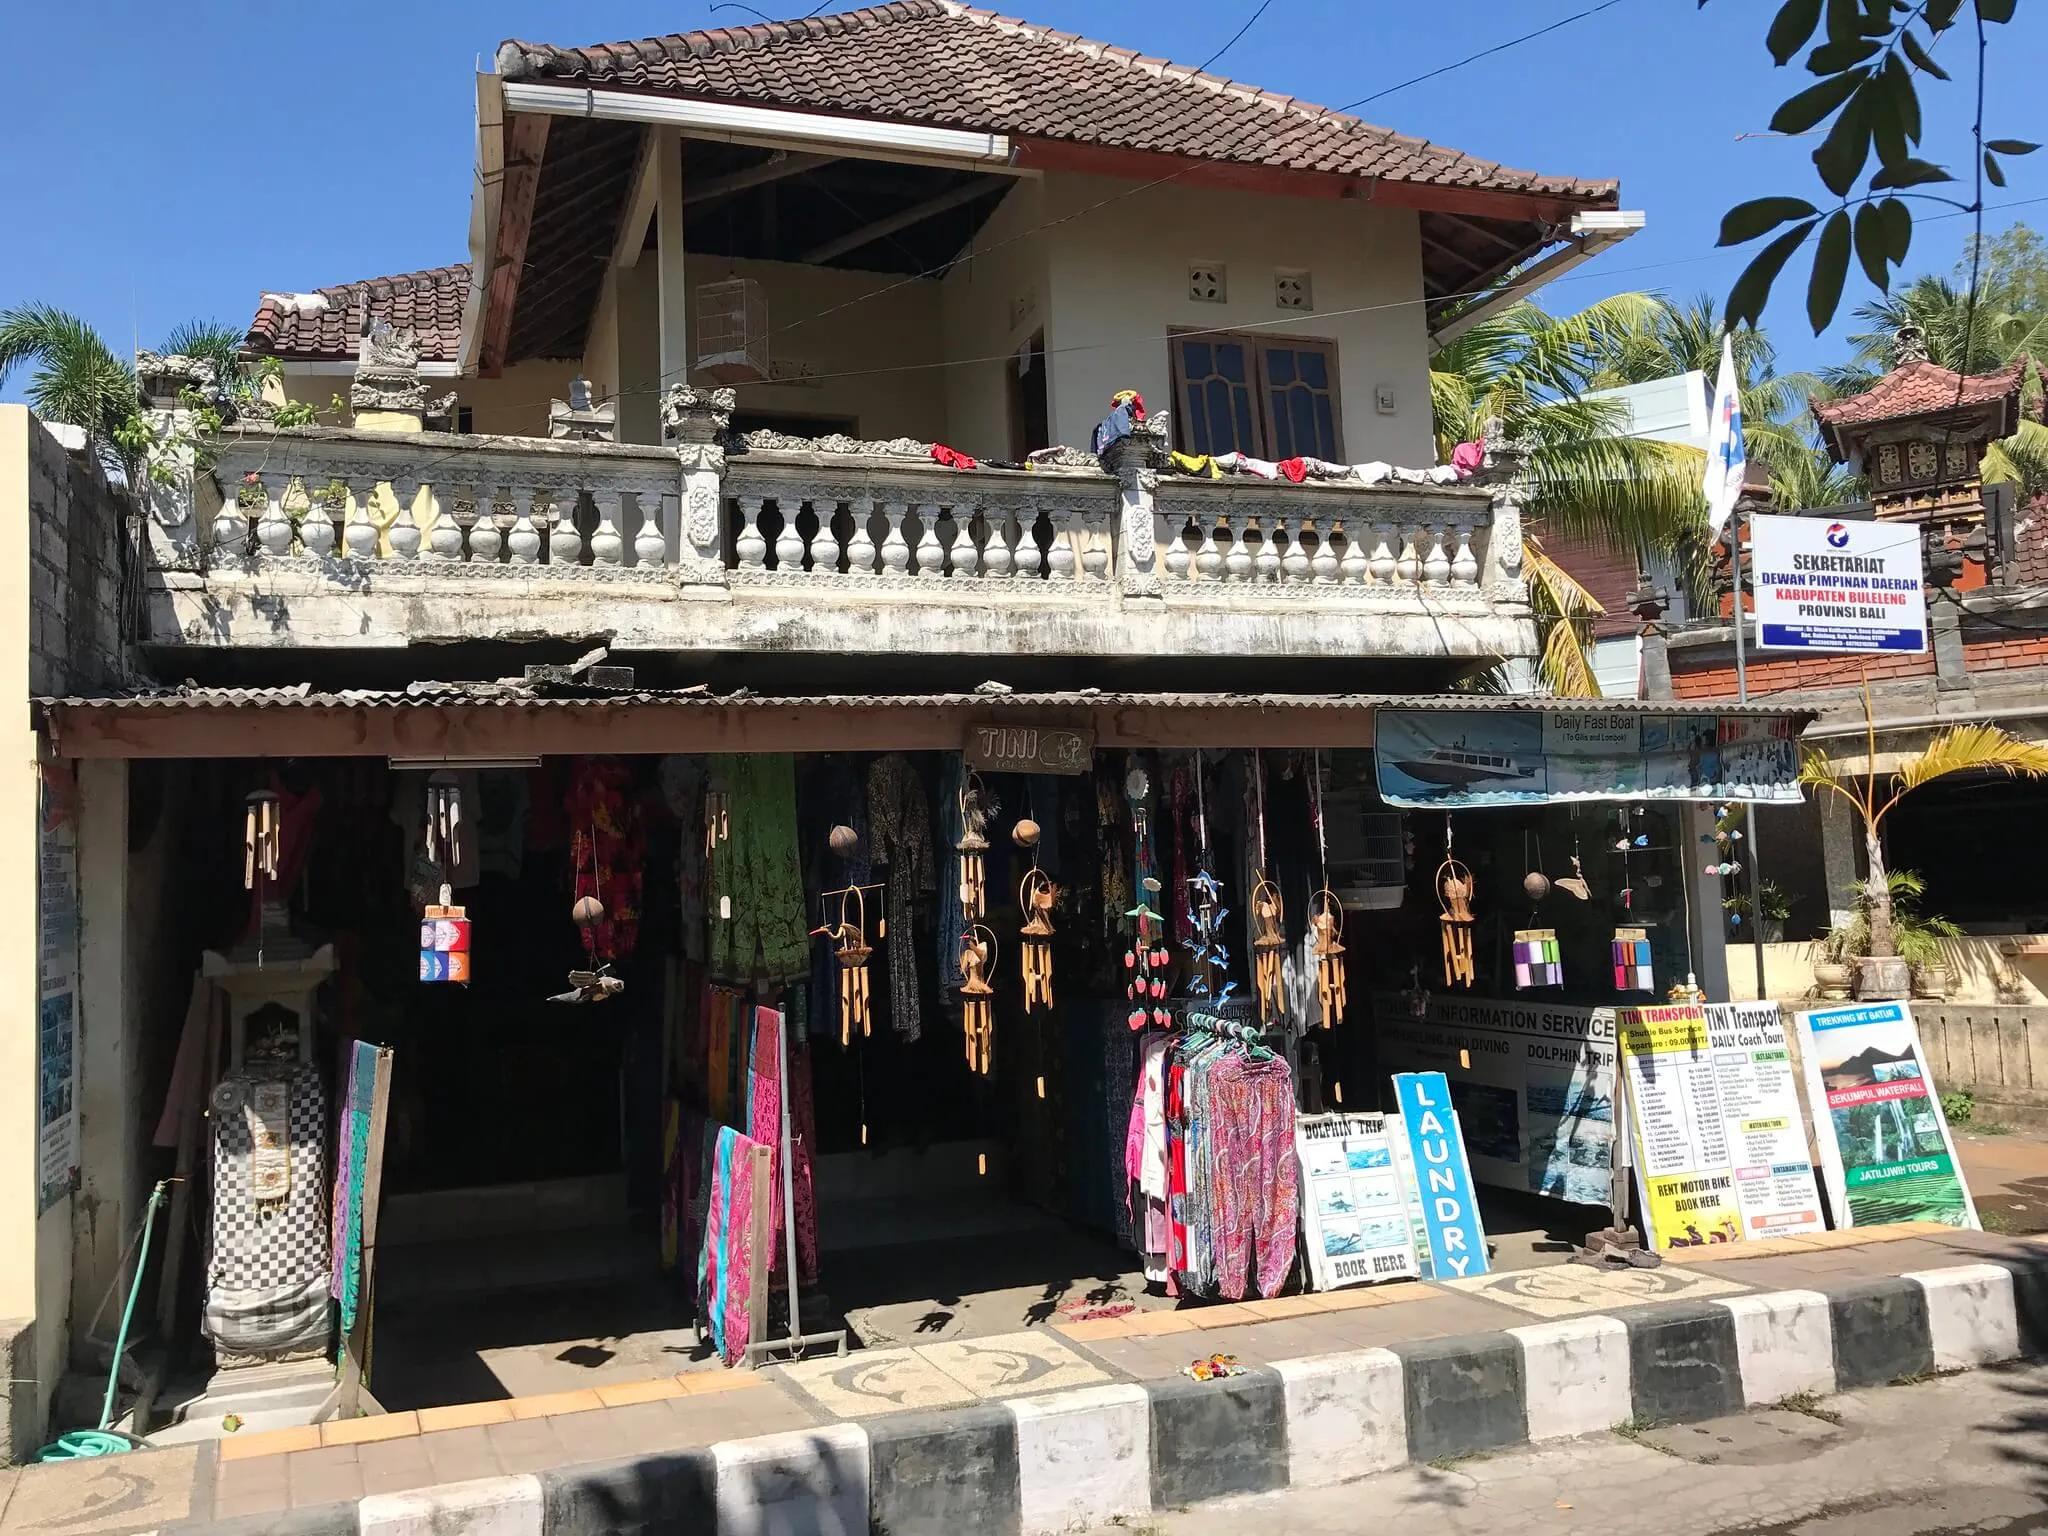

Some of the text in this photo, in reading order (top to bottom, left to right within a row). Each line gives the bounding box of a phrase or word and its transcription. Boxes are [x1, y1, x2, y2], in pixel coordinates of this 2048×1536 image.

[1794, 554, 1885, 573] SEKRETARIAT
[1762, 573, 1918, 590] DEWAN PIMPINAN DAERAH
[1776, 589, 1906, 605] KABUPATEN BULELENG
[1799, 605, 1885, 619] PROVINSI BALI
[1555, 715, 1634, 732] Daily Fast Boat
[978, 728, 1037, 759] TINI
[1437, 1005, 1537, 1030] INFORMATION
[1543, 1015, 1615, 1037] SERVICE
[1621, 1006, 1704, 1024] TINI TRANSPORT
[1705, 1005, 1782, 1032] TINI Transport
[1817, 1009, 1894, 1027] TREKKING MT BATUR
[1630, 1029, 1656, 1037] Shuttle
[1712, 1032, 1784, 1048] DAILY Coach Tours
[1472, 1039, 1509, 1054] DIVING
[1625, 1041, 1662, 1050] Departure
[1669, 1038, 1689, 1046] 09.00
[1528, 1044, 1614, 1067] DOLPHIN TRIP
[1830, 1083, 1925, 1105] SEKUMPUL WATERFALL
[1305, 1122, 1352, 1140] DOLPHIN
[1415, 1083, 1469, 1277] LAUNDRY
[1859, 1160, 1938, 1182] JATILUWIH TOURS
[1657, 1182, 1679, 1196] RENT
[1680, 1179, 1711, 1195] MOTOR
[1711, 1176, 1731, 1190] BIKE
[1675, 1195, 1720, 1212] BOOK HERE
[1336, 1254, 1407, 1279] BOOK HERE
